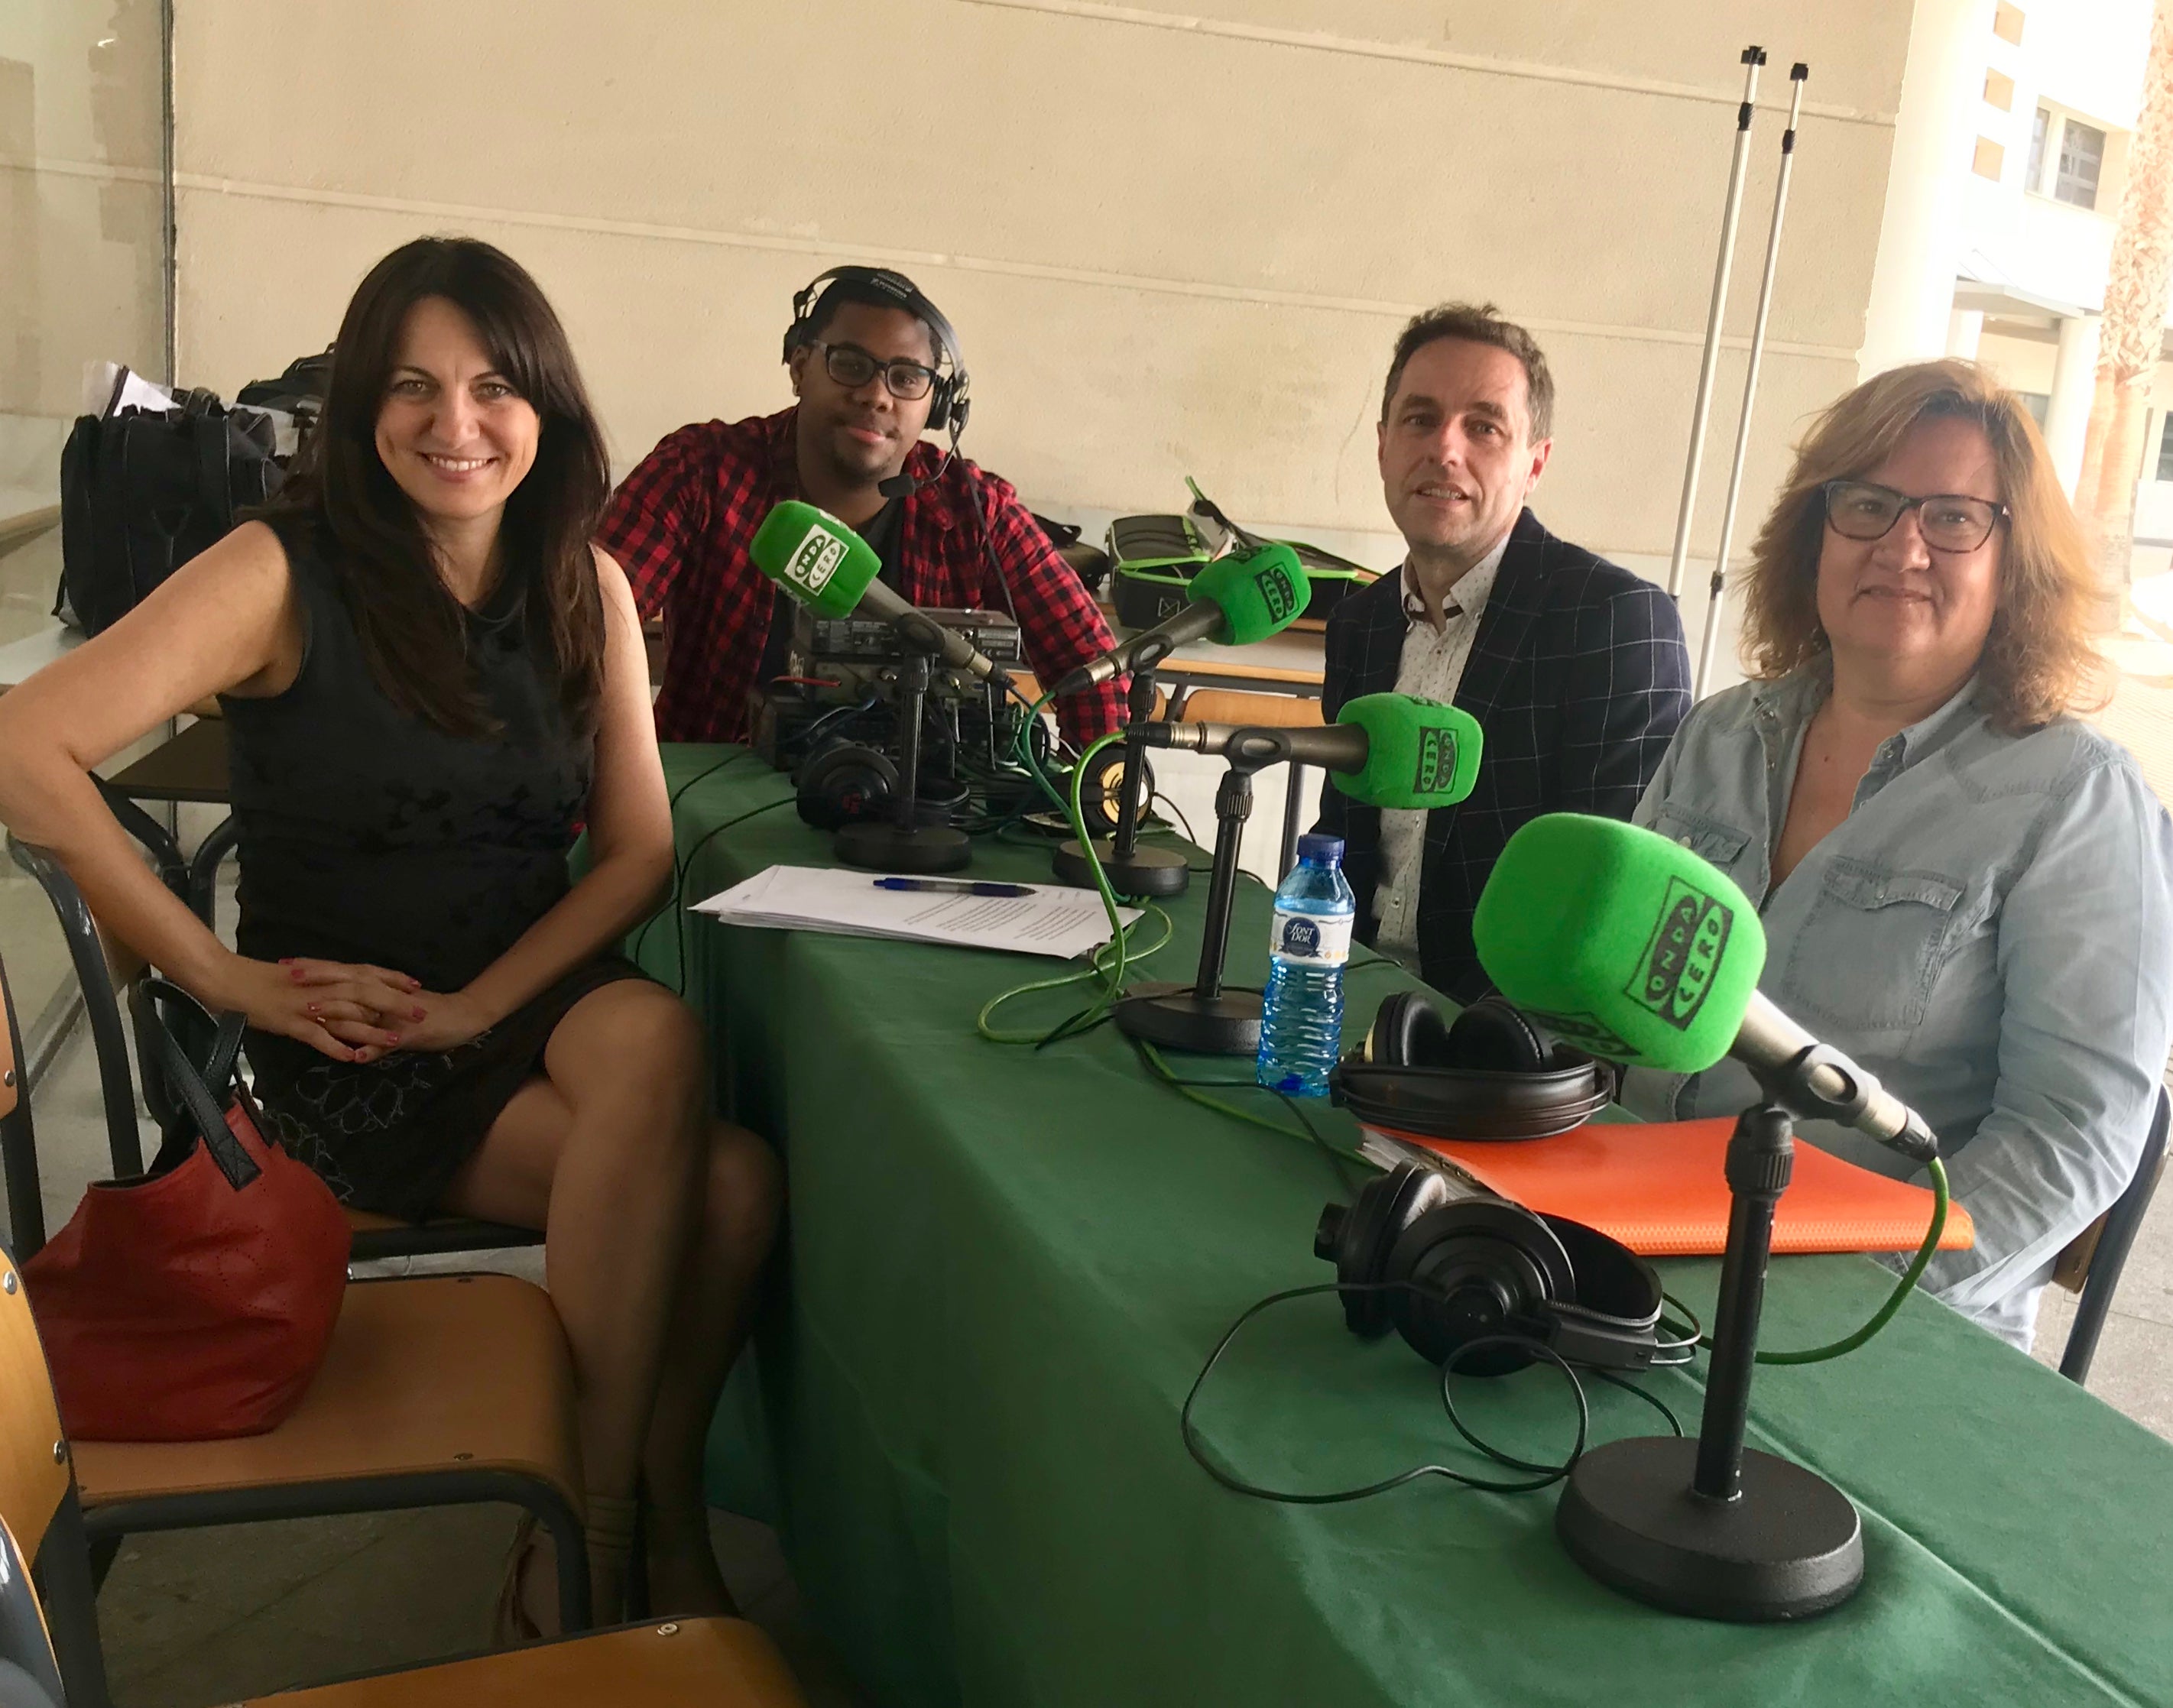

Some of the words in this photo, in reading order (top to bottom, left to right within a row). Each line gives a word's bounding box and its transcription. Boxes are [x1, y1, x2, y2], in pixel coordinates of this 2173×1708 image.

[797, 537, 825, 575] ONDA
[812, 546, 837, 582] CERO
[1265, 579, 1284, 615] CERO
[1275, 572, 1293, 608] ONDA
[1423, 739, 1437, 784] CERO
[1438, 737, 1451, 784] ONDA
[1649, 905, 1696, 992] ONDA
[1678, 919, 1721, 1002] CERO
